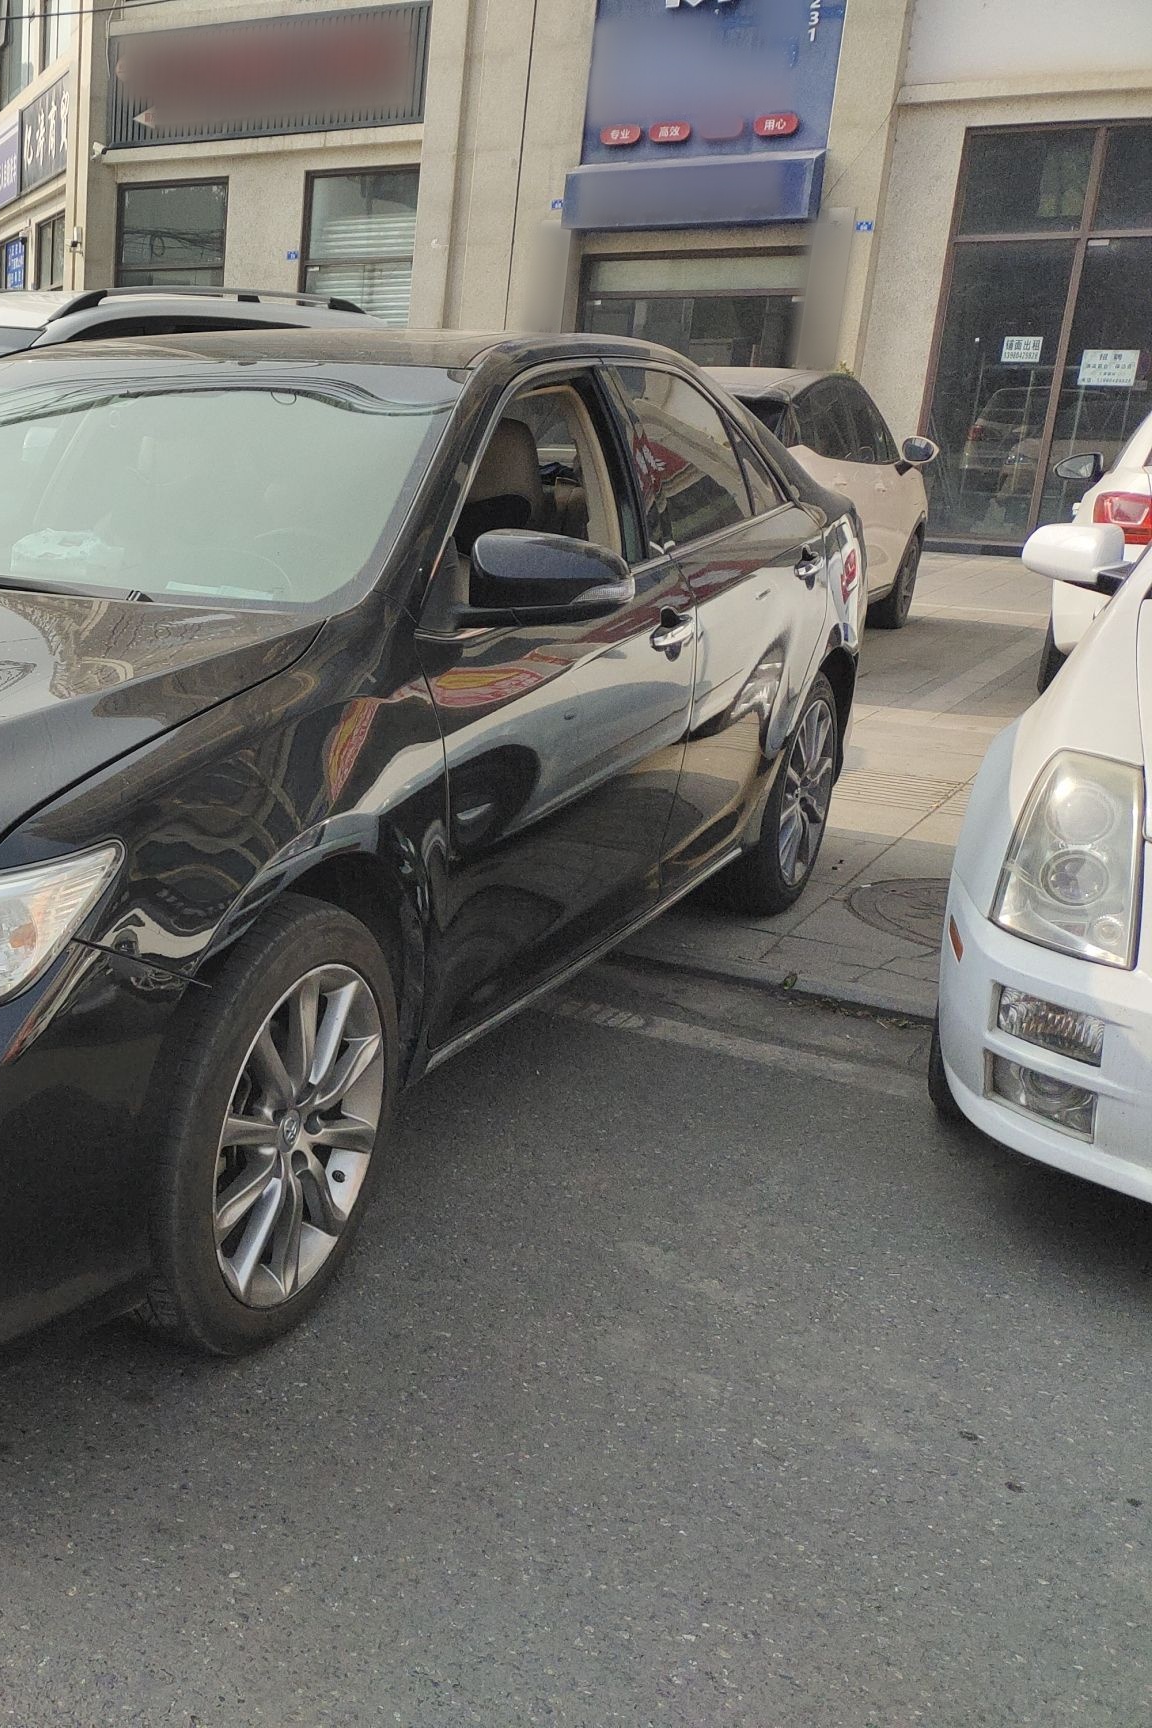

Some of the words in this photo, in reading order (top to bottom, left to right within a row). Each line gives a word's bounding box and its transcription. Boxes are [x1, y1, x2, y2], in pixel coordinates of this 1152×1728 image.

[764, 118, 787, 130] 用心
[609, 129, 631, 140] 专业
[658, 125, 681, 138] 高效
